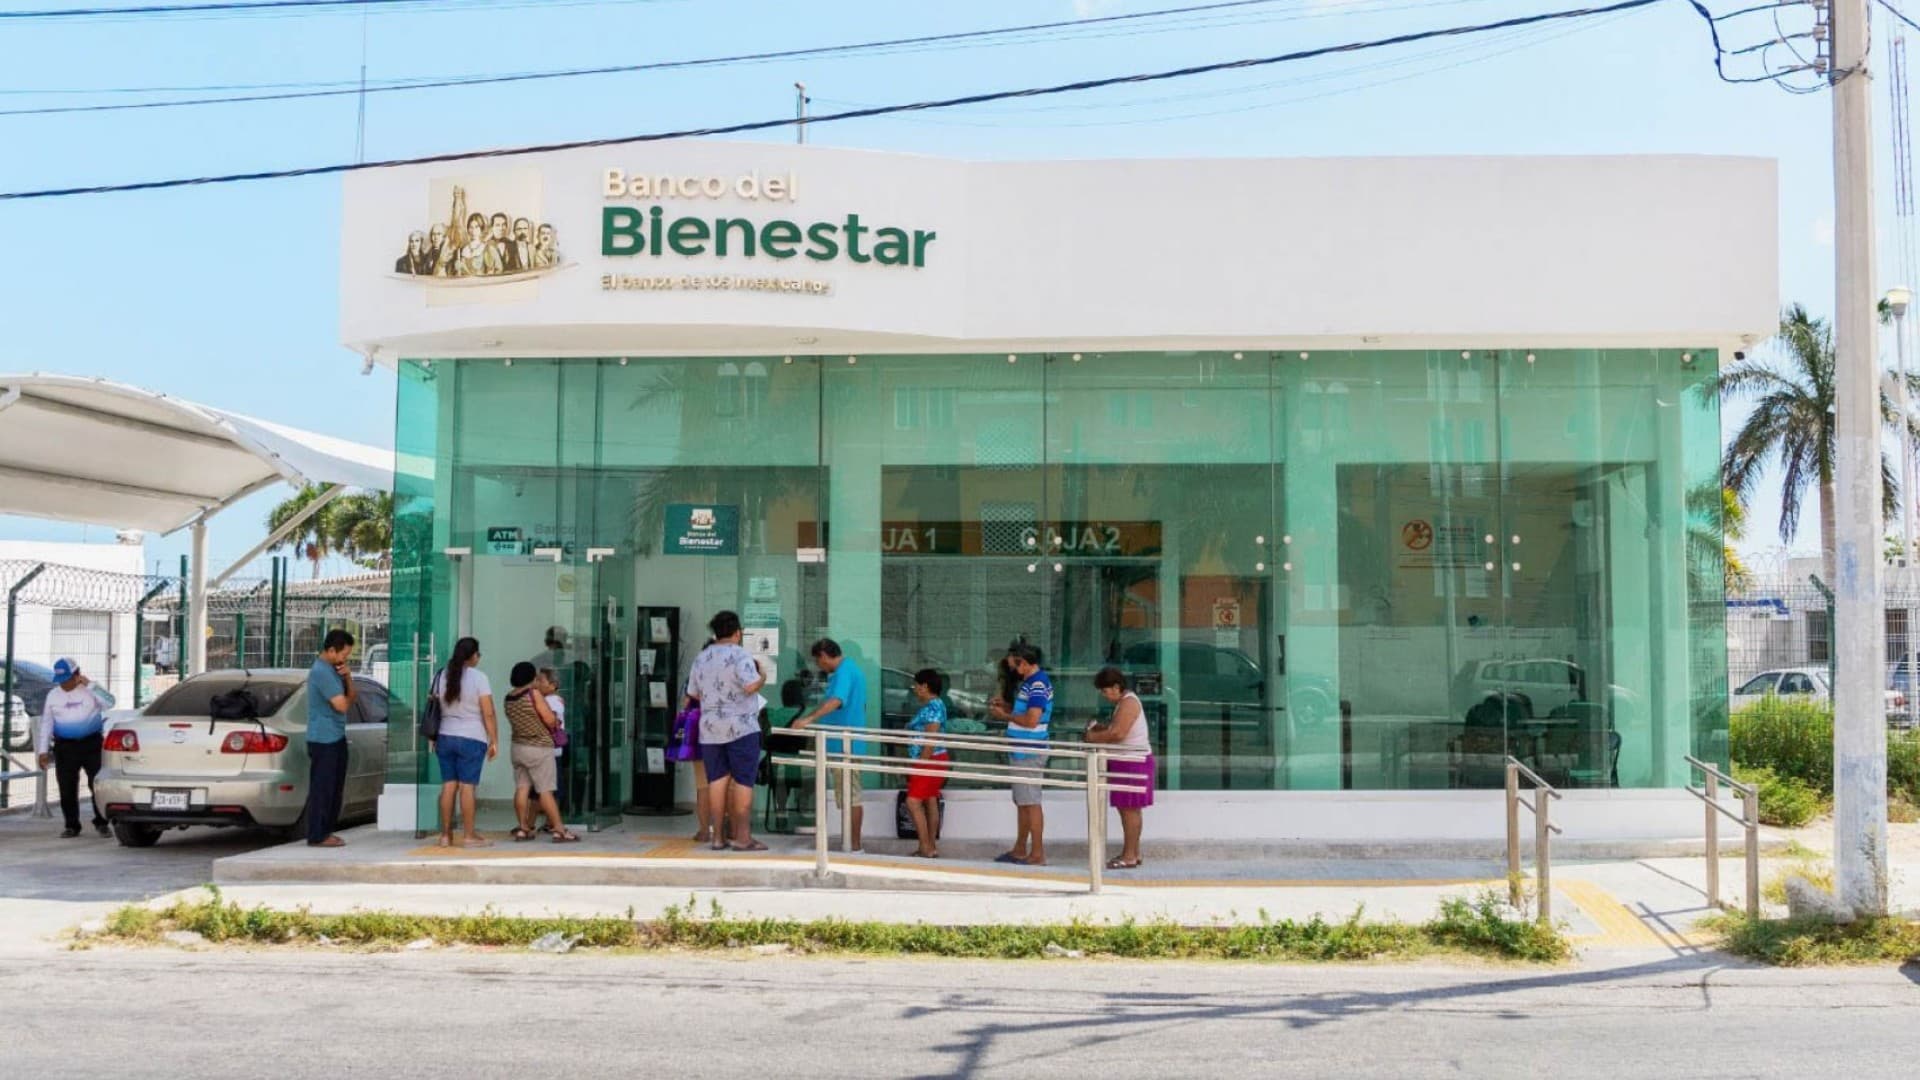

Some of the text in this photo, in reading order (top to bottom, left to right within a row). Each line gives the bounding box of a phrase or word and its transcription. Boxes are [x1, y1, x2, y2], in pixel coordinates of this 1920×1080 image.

[603, 168, 798, 200] Banco del
[601, 205, 937, 267] Bienestar
[600, 272, 617, 289] El
[621, 272, 674, 290] banco
[678, 273, 702, 289] de
[493, 530, 518, 540] ATM
[882, 527, 937, 550] JA 1
[1020, 526, 1121, 550] CAJA 2
